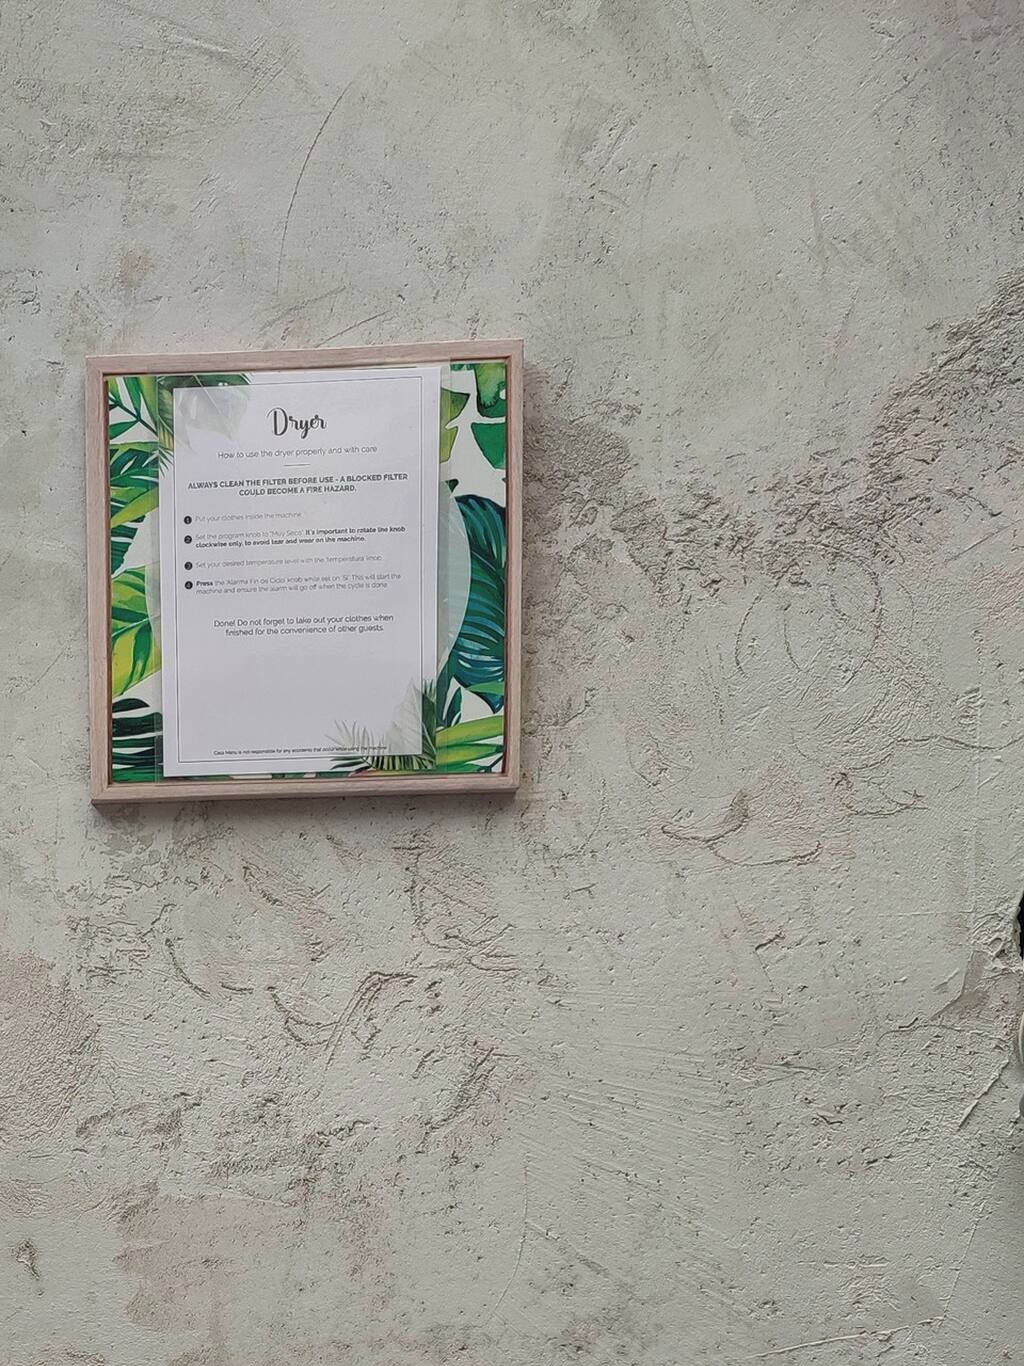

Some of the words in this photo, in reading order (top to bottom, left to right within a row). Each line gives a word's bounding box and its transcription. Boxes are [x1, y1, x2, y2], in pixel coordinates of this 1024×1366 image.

[266, 407, 328, 440] Dryer
[274, 449, 294, 458] dryer
[295, 448, 326, 457] properly
[219, 480, 244, 488] CLEAN
[262, 478, 286, 486] FILTER
[346, 474, 382, 482] BLOCKED
[267, 487, 298, 495] BECOME
[214, 619, 236, 627] Done!
[263, 618, 285, 627] forget
[327, 617, 343, 625] your
